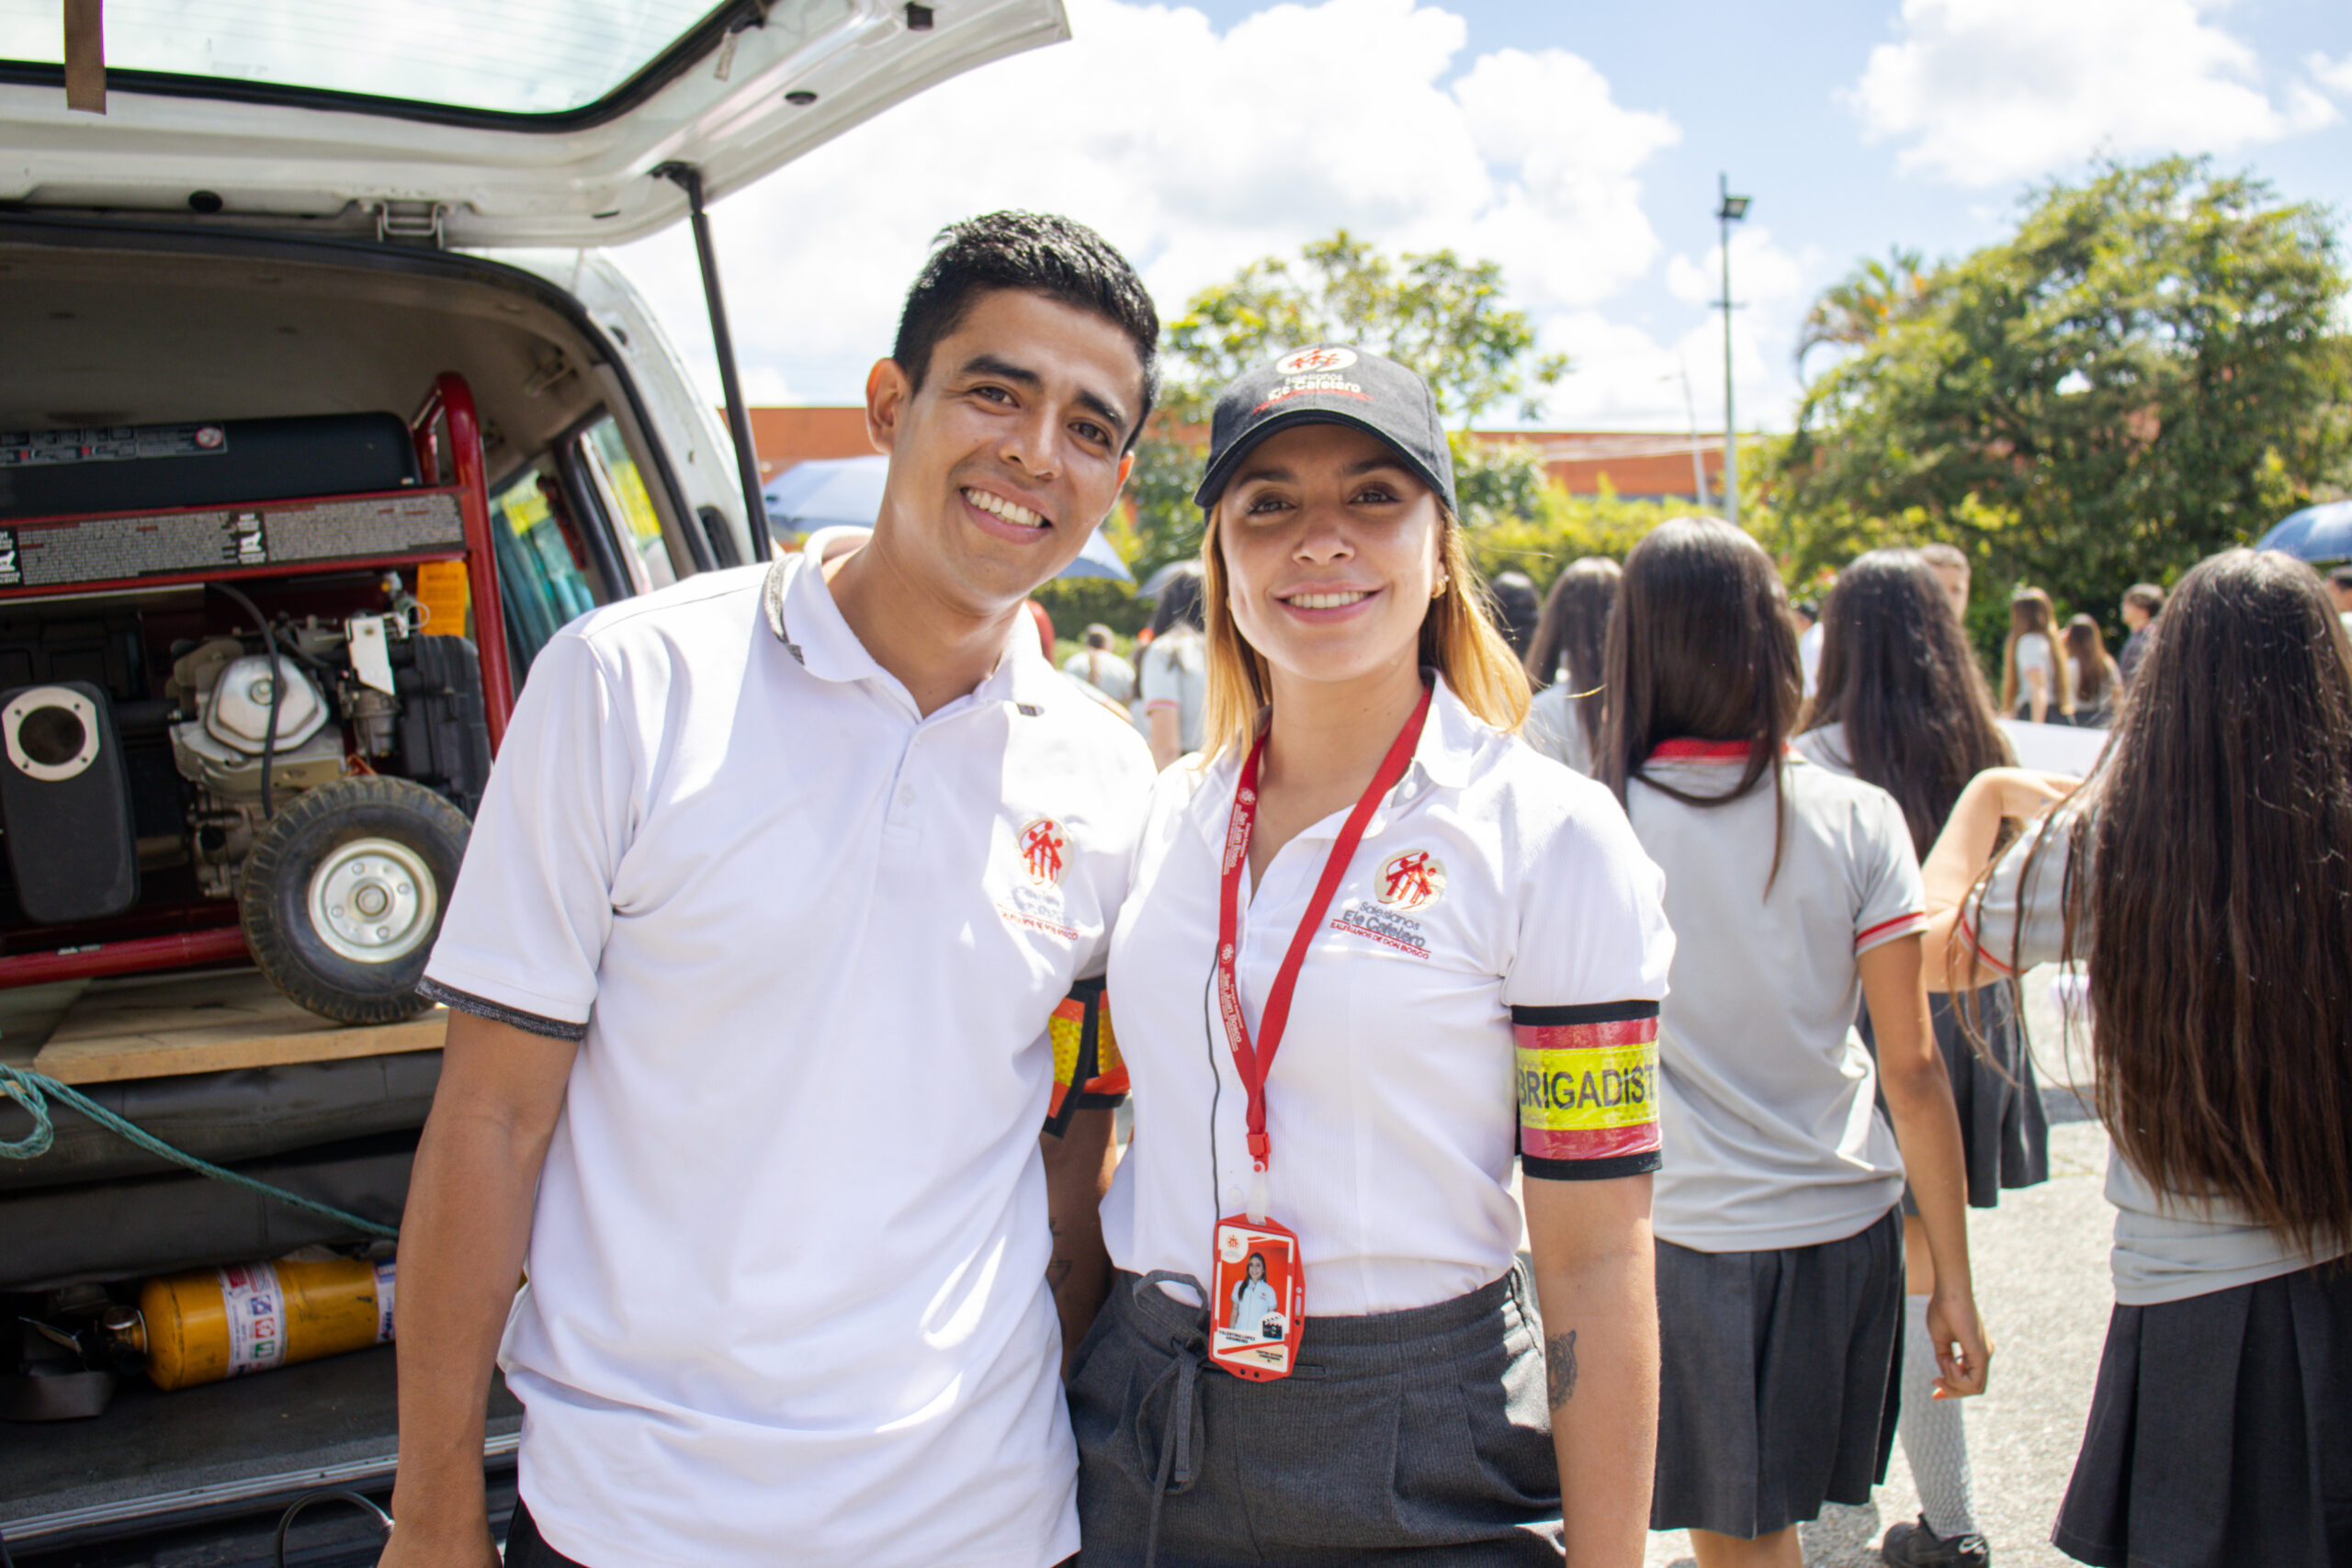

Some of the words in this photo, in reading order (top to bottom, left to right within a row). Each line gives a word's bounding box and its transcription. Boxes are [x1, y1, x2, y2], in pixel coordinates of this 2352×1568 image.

[1294, 379, 1362, 393] Cafetero
[1360, 901, 1420, 931] Salesianos
[1366, 917, 1426, 947] Cafetero
[1383, 938, 1399, 949] DON
[1400, 943, 1429, 959] BOSCO
[1229, 1013, 1242, 1043] Bosco
